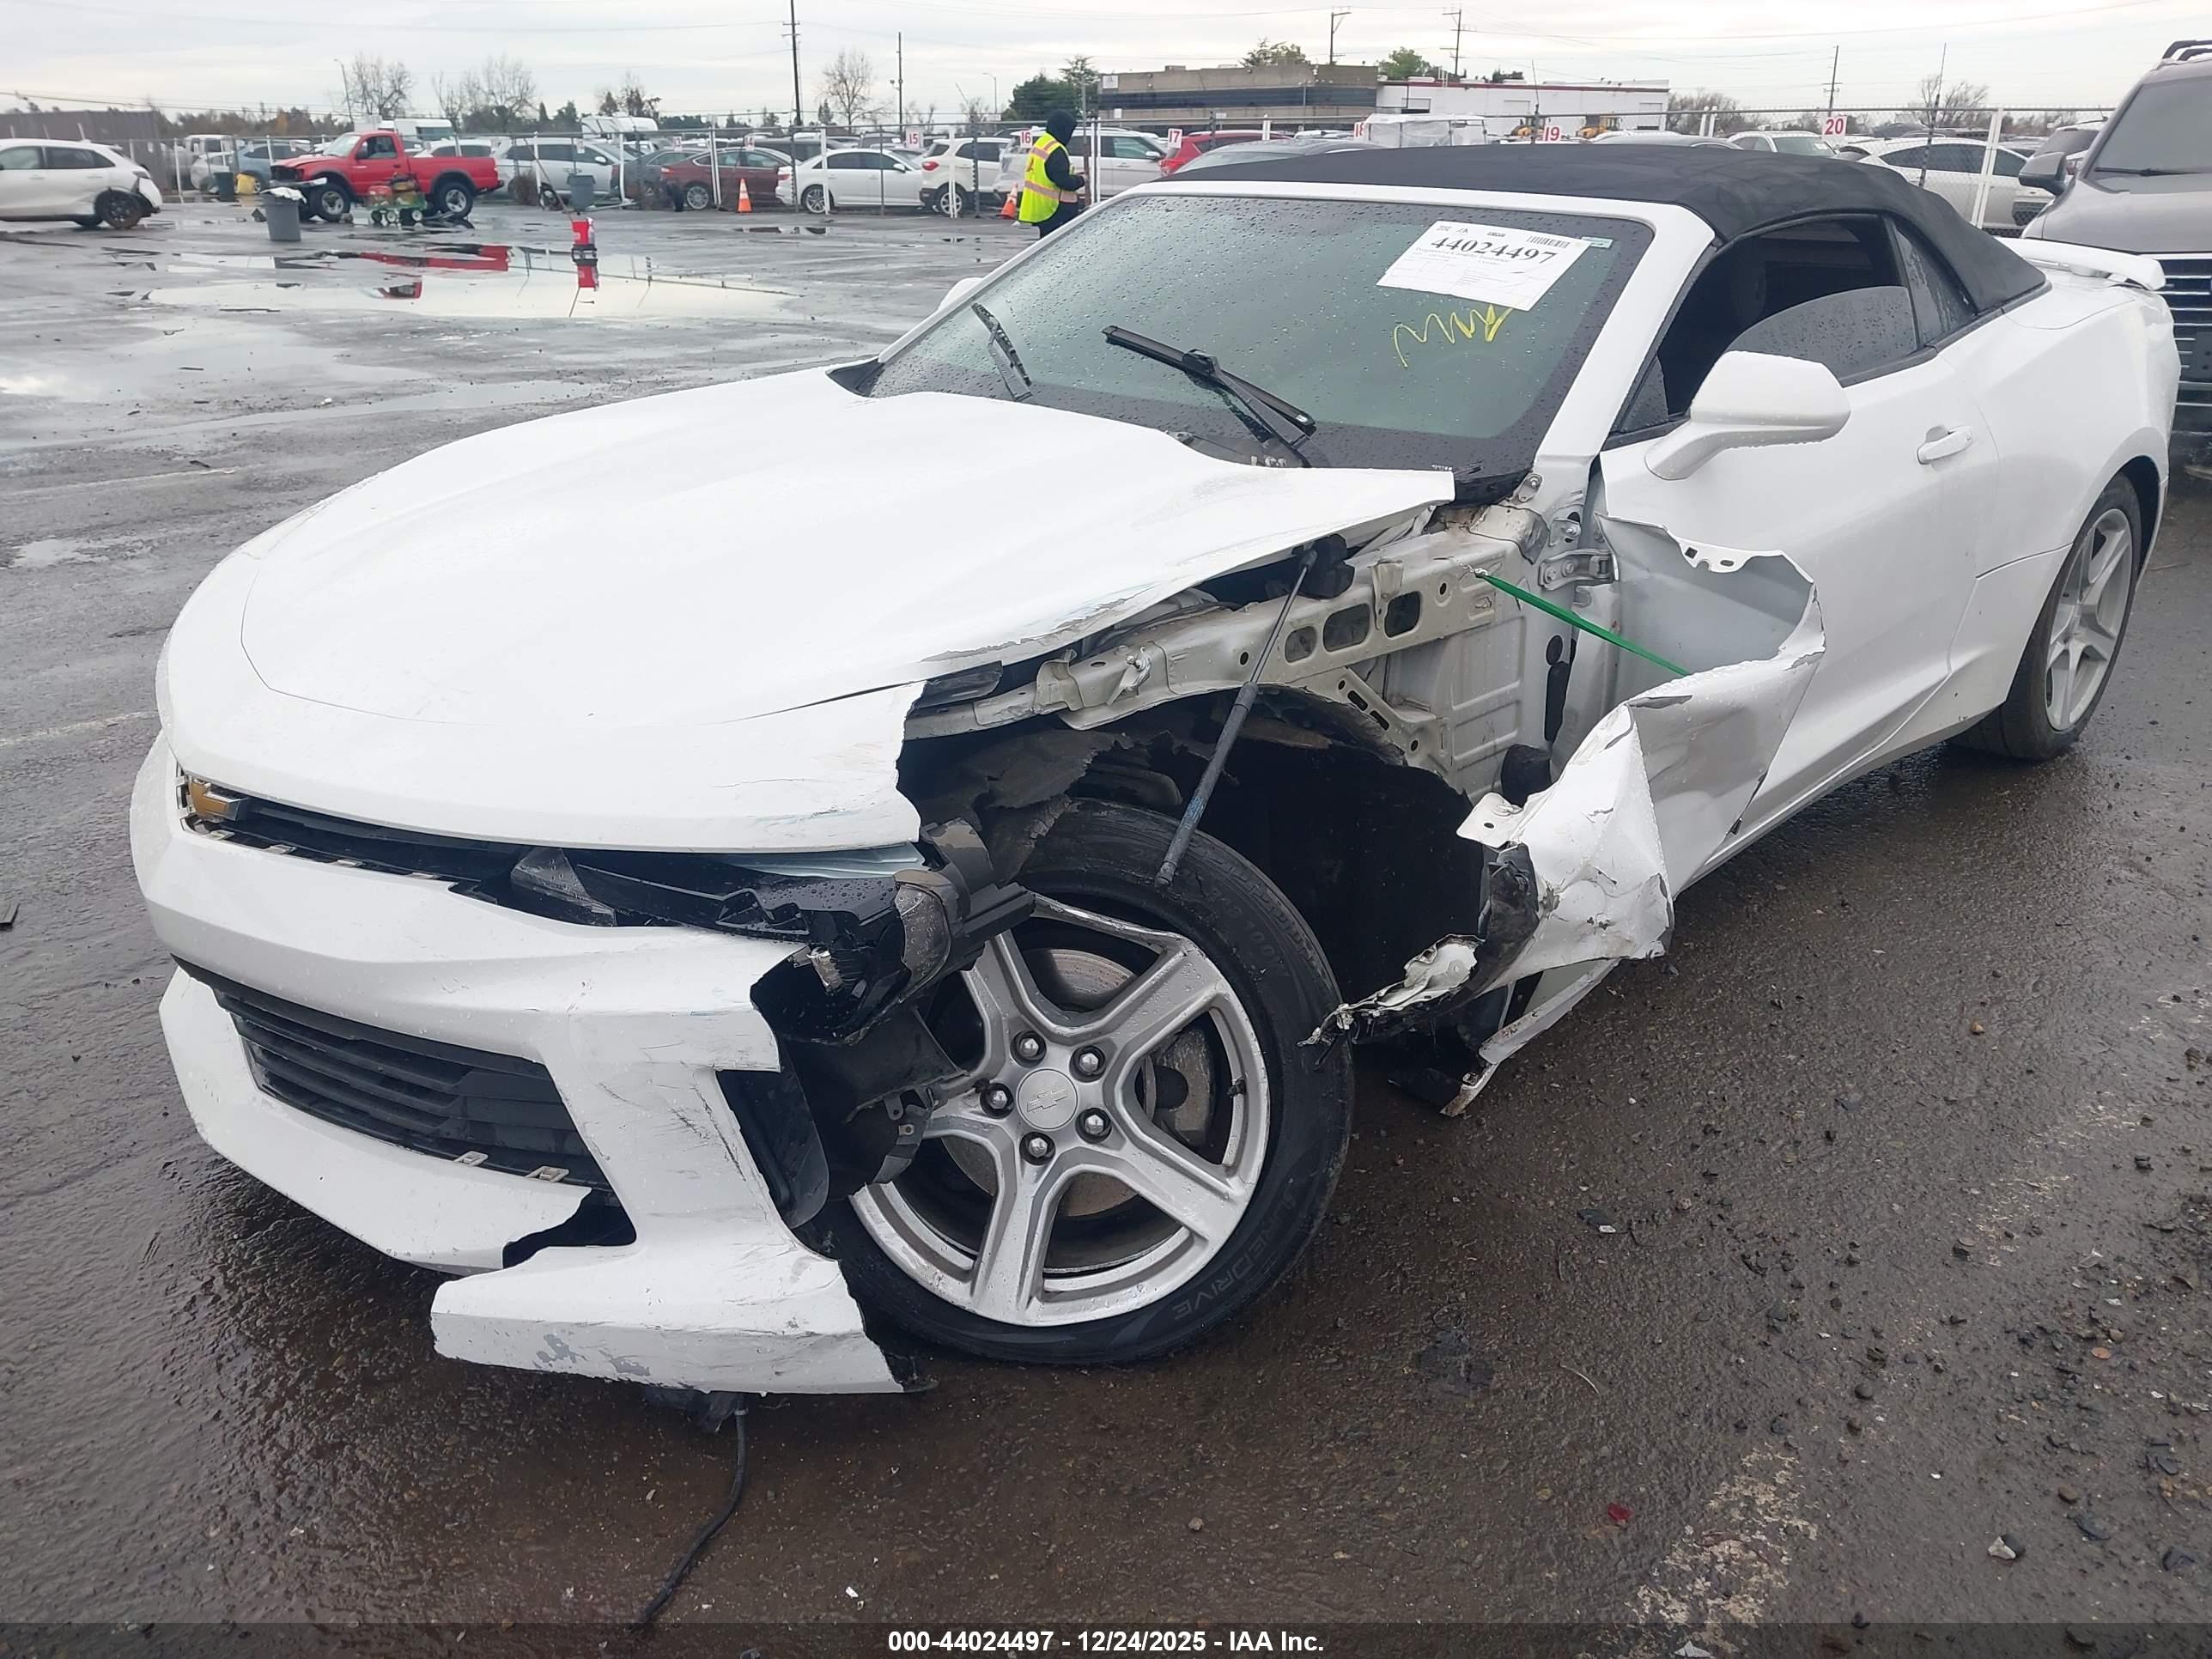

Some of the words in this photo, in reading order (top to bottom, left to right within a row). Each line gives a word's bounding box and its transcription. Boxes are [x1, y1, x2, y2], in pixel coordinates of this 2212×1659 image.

[1825, 118, 1844, 135] 20
[908, 133, 919, 144] 15
[1021, 131, 1031, 143] 16
[1169, 130, 1181, 143] 17
[1545, 126, 1560, 142] 19
[1431, 237, 1558, 264] 44024497
